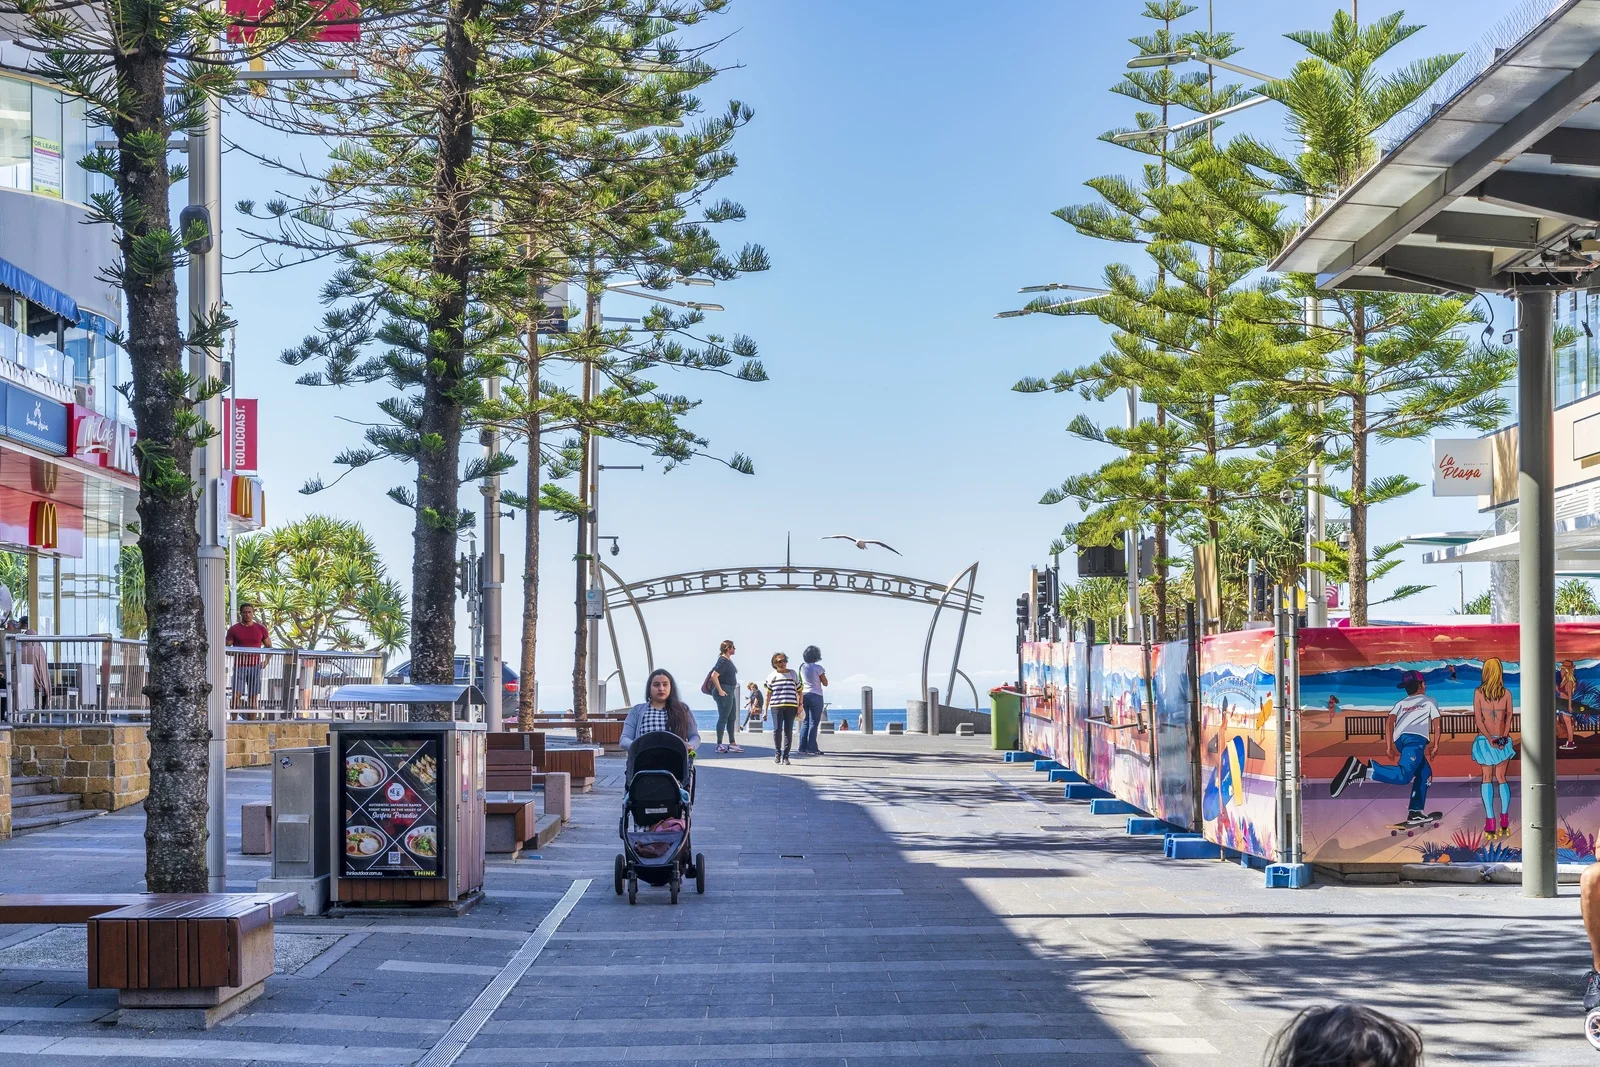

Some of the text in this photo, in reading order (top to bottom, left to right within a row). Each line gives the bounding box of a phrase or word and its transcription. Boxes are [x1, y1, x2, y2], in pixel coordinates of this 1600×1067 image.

[42, 142, 60, 152] LEASE
[235, 405, 246, 466] GOLDCOAST.
[1439, 453, 1455, 469] La
[1442, 466, 1482, 480] Playa
[646, 571, 932, 599] SURFERS PARADISE
[372, 811, 418, 820] Surfers Paradise
